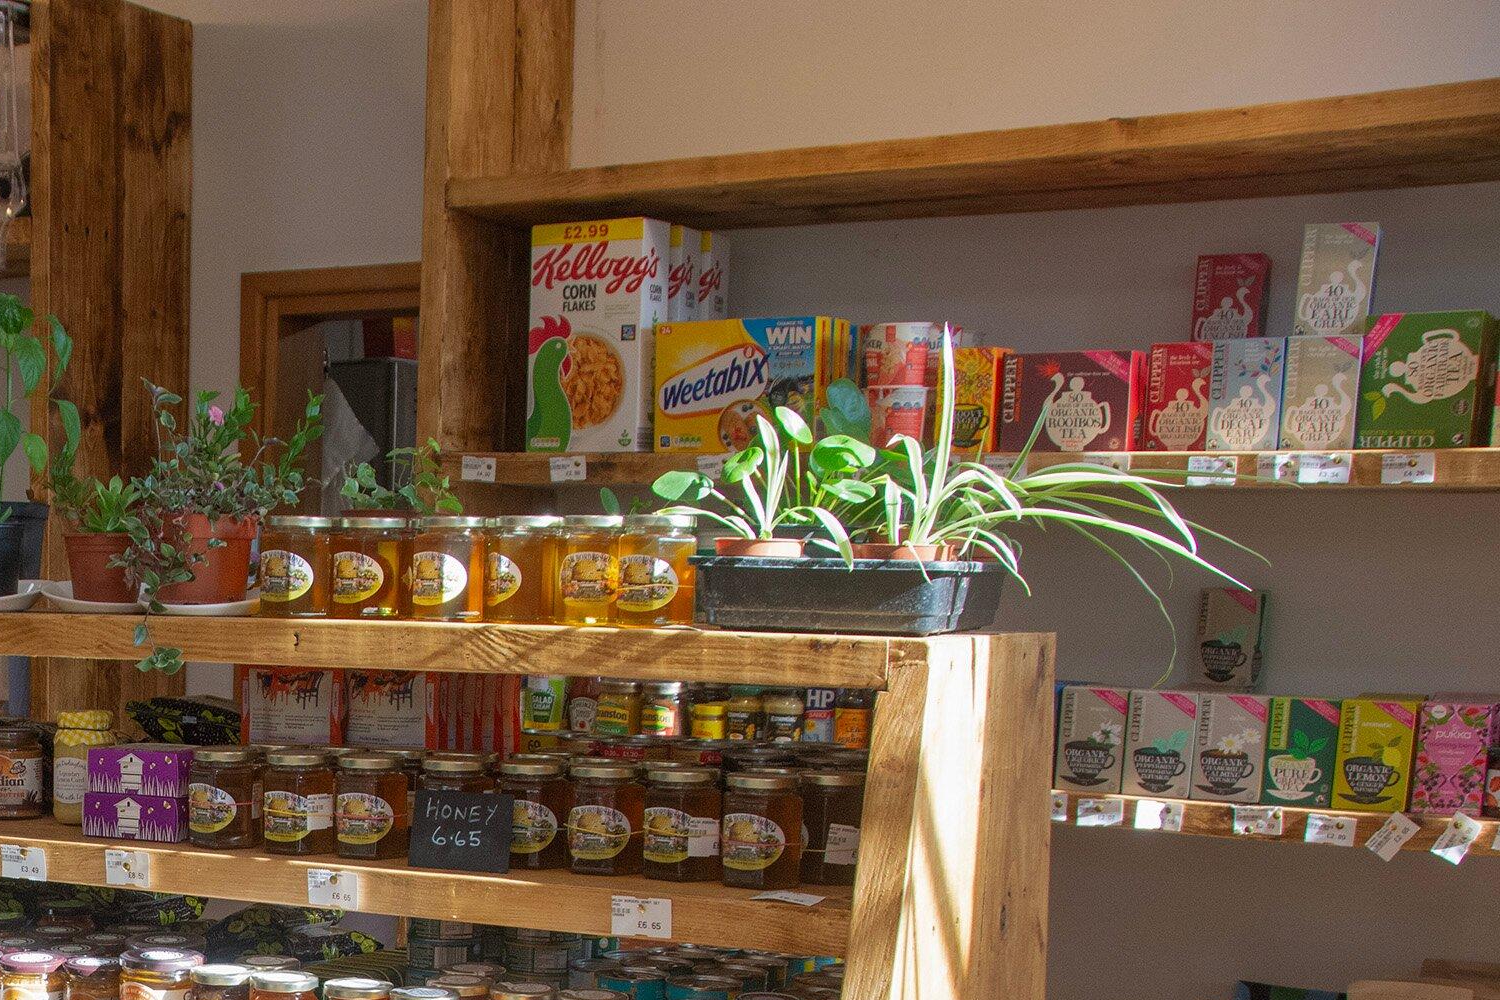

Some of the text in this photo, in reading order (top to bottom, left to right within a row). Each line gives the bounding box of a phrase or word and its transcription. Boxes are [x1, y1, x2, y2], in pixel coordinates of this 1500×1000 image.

[563, 224, 609, 239] £2.99
[532, 240, 660, 294] Kellogg's
[562, 284, 597, 300] CORN
[562, 299, 596, 312] FLAKES
[661, 326, 672, 334] 24
[765, 325, 812, 345] WIN
[663, 353, 770, 410] Weetabix
[1150, 349, 1165, 403] CLIPPER
[1002, 358, 1018, 423] CLIPPER
[1051, 409, 1098, 417] ORGANIC
[1049, 417, 1100, 428] ROOIBOS
[1220, 419, 1265, 430] DECAF
[1298, 422, 1337, 432] EARL
[1060, 428, 1087, 438] TEA
[1159, 426, 1202, 434] ENGLISH
[1300, 432, 1333, 442] GREY
[1359, 436, 1435, 447] CLIPPER
[532, 694, 552, 703] SALAD
[807, 689, 834, 708] HP
[1131, 696, 1143, 742] CLIPPER
[1199, 699, 1212, 746] CLIPPER
[1272, 701, 1285, 748] CLIPPER
[1435, 728, 1473, 741] pukka
[1065, 748, 1108, 759] ORGANIC
[1135, 755, 1180, 765] ORGANIC
[1201, 757, 1247, 766] ORGANIC
[1274, 767, 1309, 778] PURE
[1346, 764, 1392, 774] ORGANIC
[1348, 771, 1388, 783] LEMON
[426, 800, 498, 825] HONEY
[637, 920, 662, 931] £6.65
